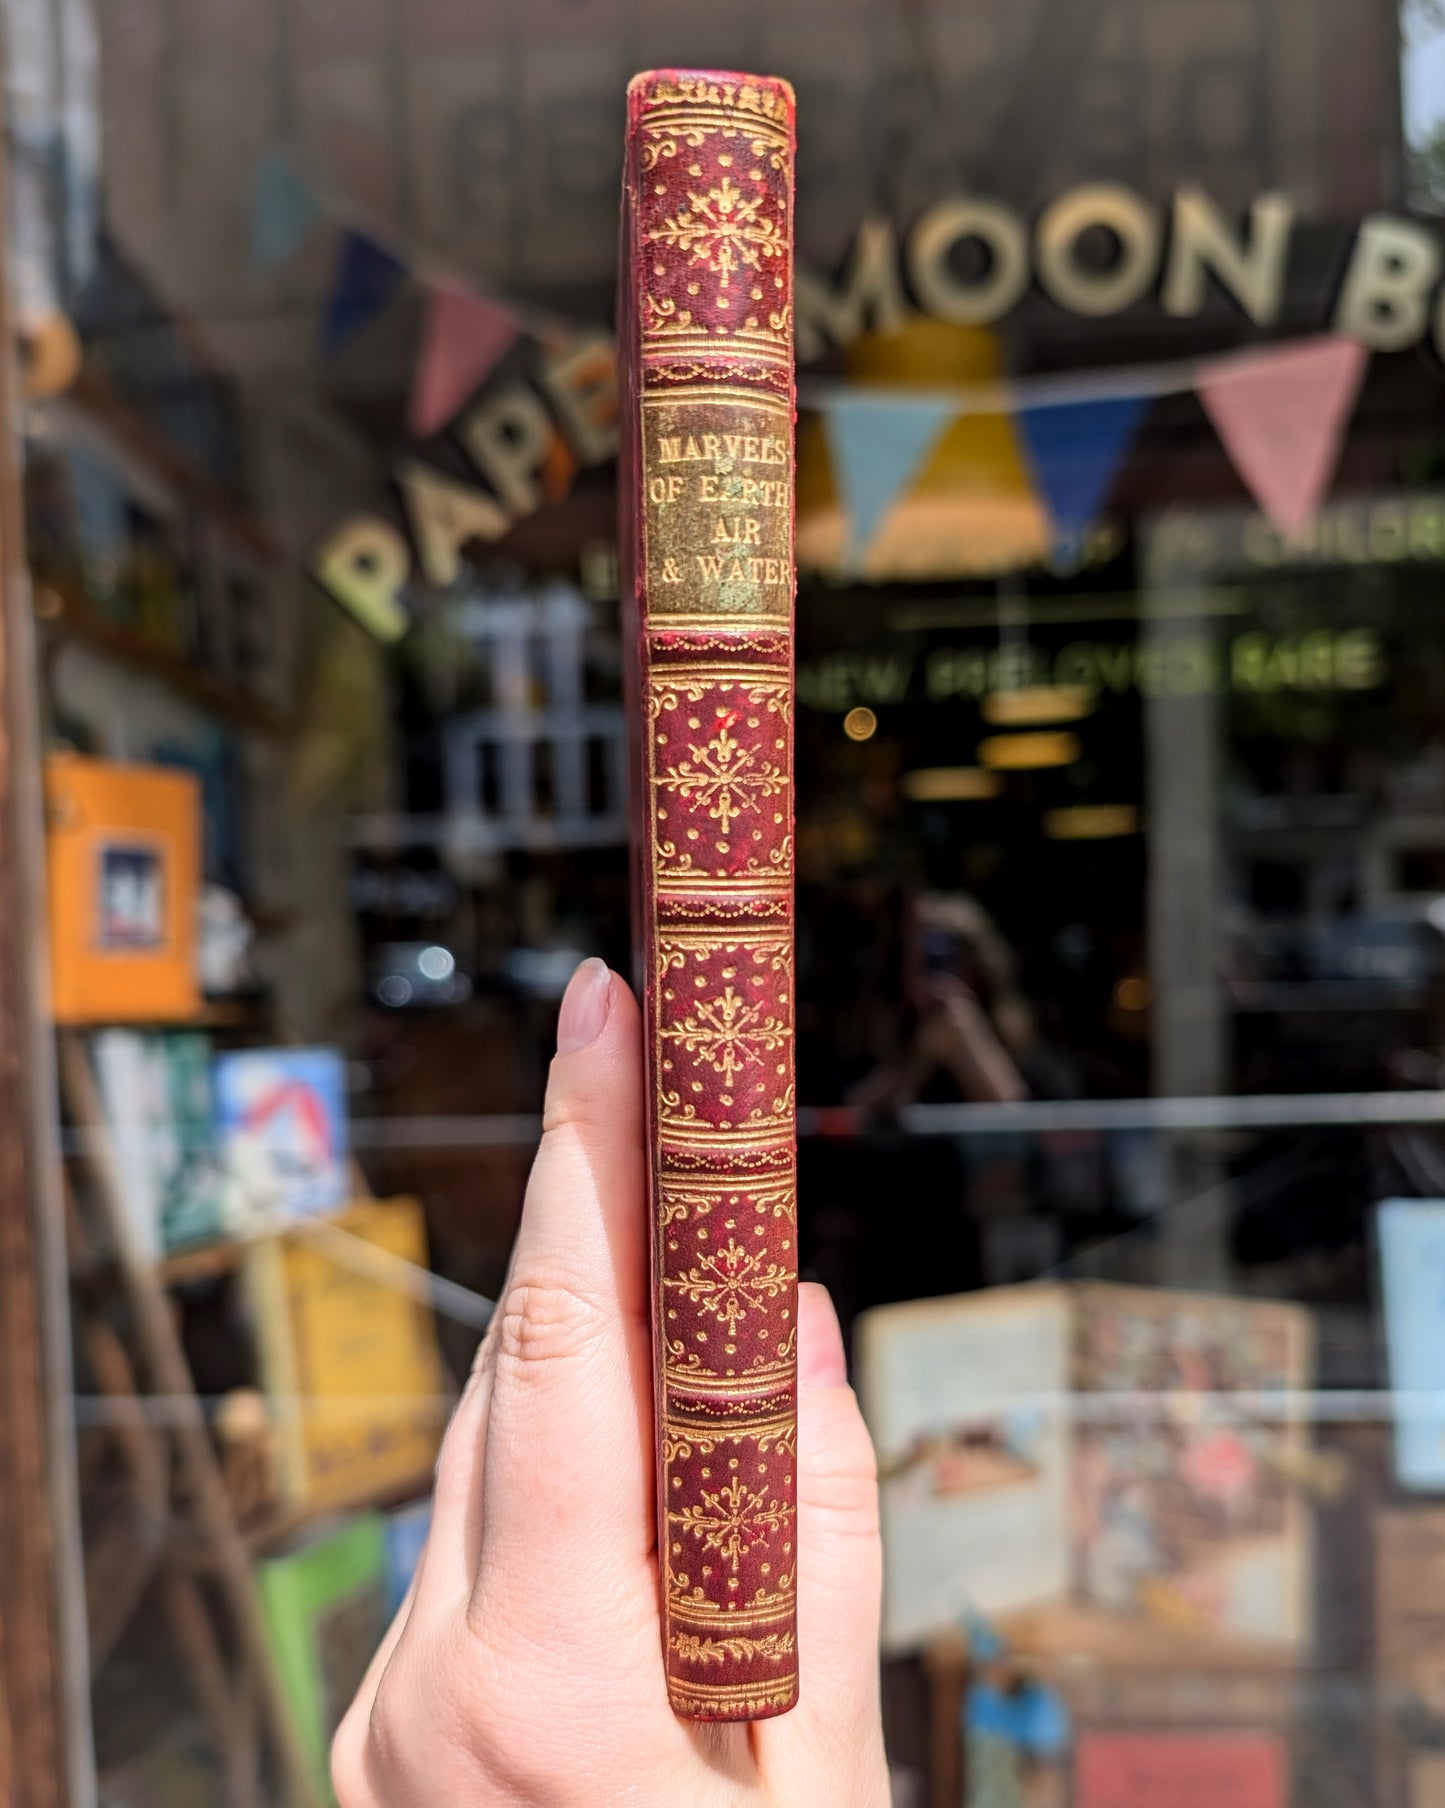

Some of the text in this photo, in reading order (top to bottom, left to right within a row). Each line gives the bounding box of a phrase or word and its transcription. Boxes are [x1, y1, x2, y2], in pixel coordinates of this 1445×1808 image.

[797, 185, 1292, 365] MOON
[1334, 212, 1445, 365] B
[657, 434, 787, 464] MARVELS
[650, 476, 684, 504] OF
[711, 517, 761, 545] AIR
[662, 555, 790, 585] & WATER
